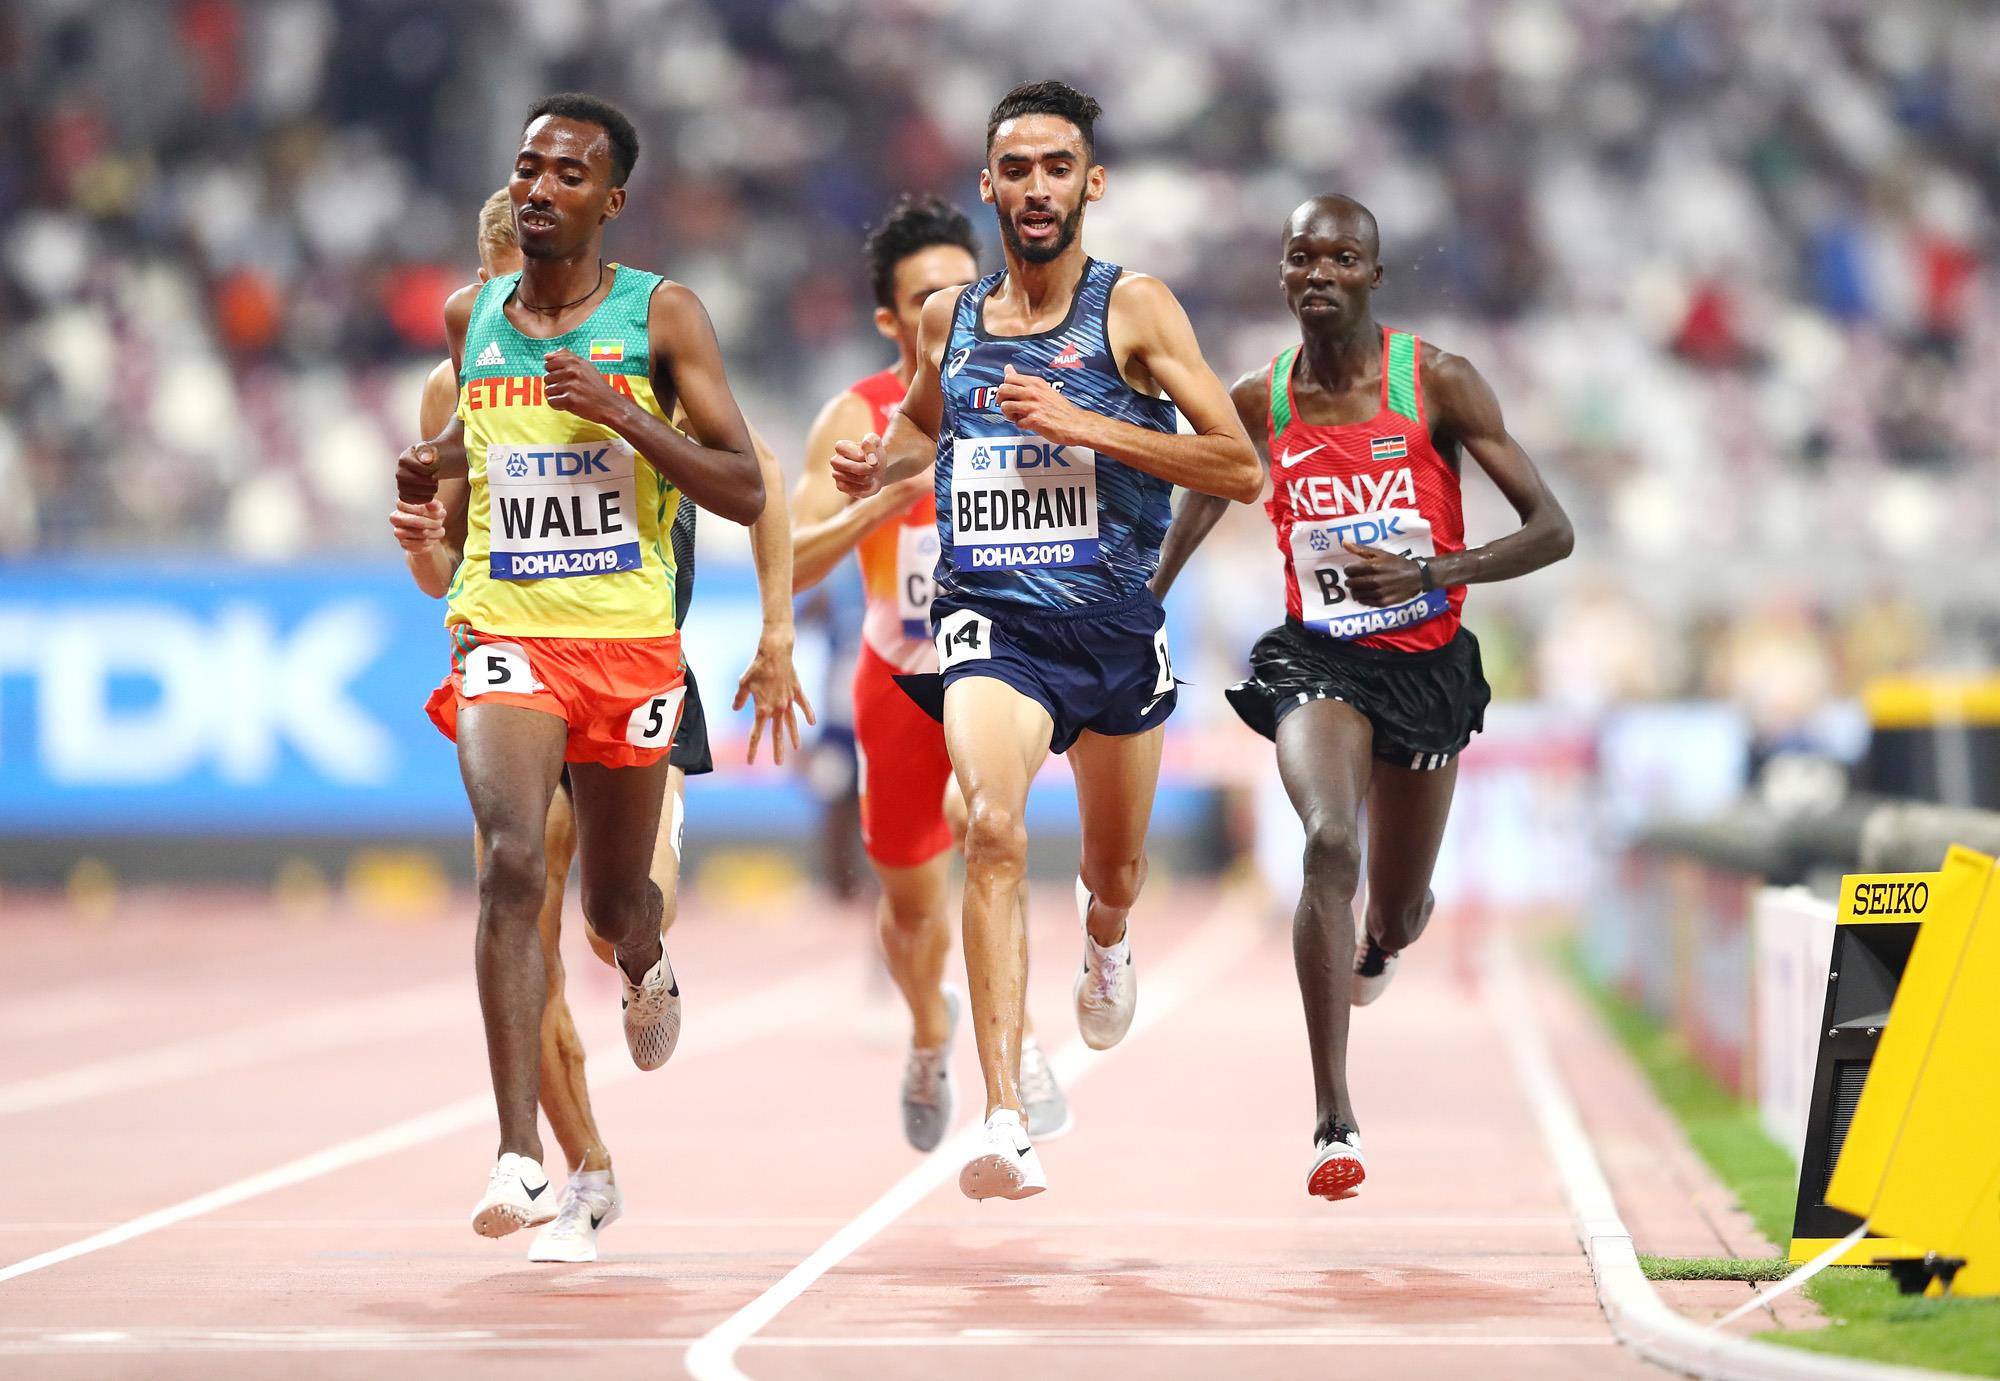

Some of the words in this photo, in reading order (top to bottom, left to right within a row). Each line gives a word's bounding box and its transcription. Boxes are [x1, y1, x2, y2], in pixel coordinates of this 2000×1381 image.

[475, 356, 506, 367] adidas
[1054, 353, 1079, 364] MAIF
[468, 374, 636, 411] ETHIA
[528, 448, 611, 477] TDK
[990, 443, 1071, 469] TDK
[957, 486, 1087, 533] BEDRANI
[1286, 467, 1416, 517] KENYA
[500, 490, 622, 540] WALE
[1327, 516, 1406, 549] TDK
[511, 550, 618, 575] DOHA2019
[972, 543, 1075, 567] DOHA2019
[1328, 600, 1429, 638] DOHA2019
[945, 618, 982, 658] 14
[487, 655, 512, 685] 5
[1159, 642, 1171, 682] 1
[0, 600, 396, 786] DK
[643, 698, 667, 739] 5
[1853, 881, 1929, 916] SEIKO
